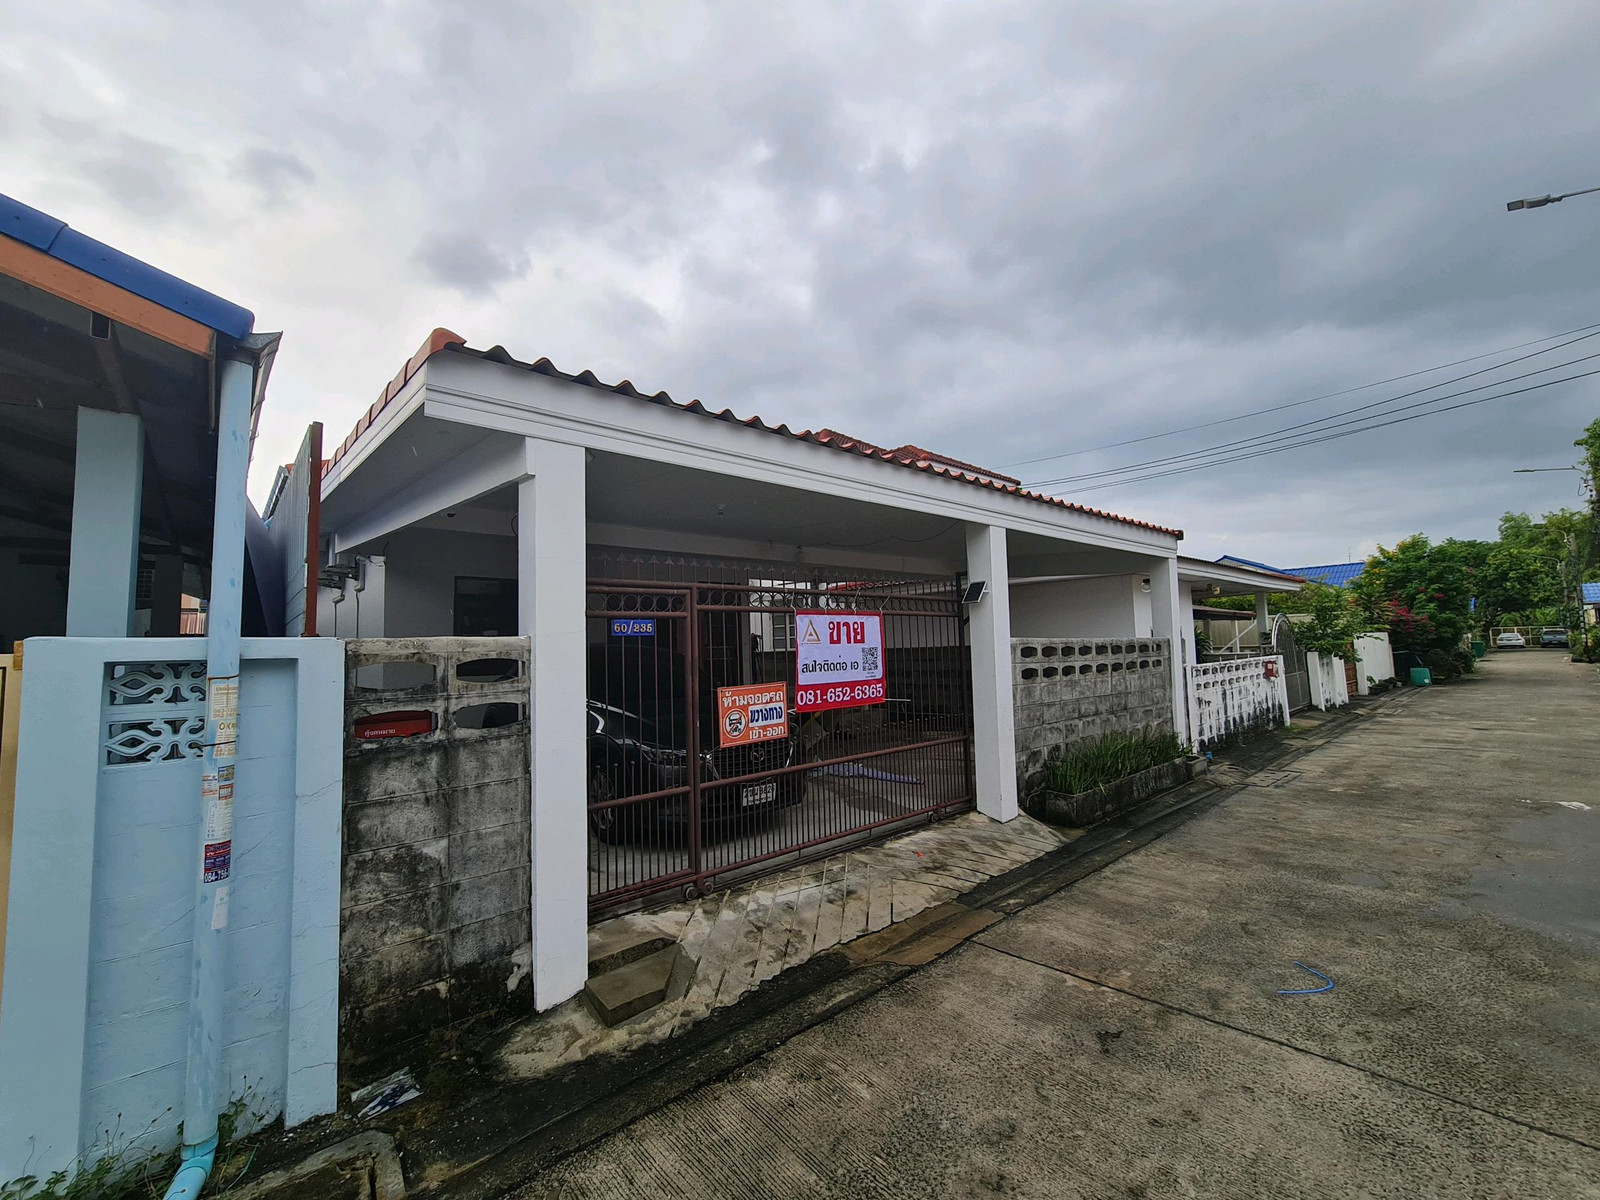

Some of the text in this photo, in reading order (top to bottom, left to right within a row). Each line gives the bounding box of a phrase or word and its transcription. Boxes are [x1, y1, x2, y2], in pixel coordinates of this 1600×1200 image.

[614, 621, 653, 635] 60/235
[828, 620, 866, 645] ขาย
[801, 655, 860, 674] สนใจติดต่อ เอ
[722, 690, 784, 708] ห้ามจอดรถ
[797, 683, 884, 706] 081-652-6365
[749, 705, 784, 724] ขวางทาง
[749, 726, 785, 740] เข้า-ออก
